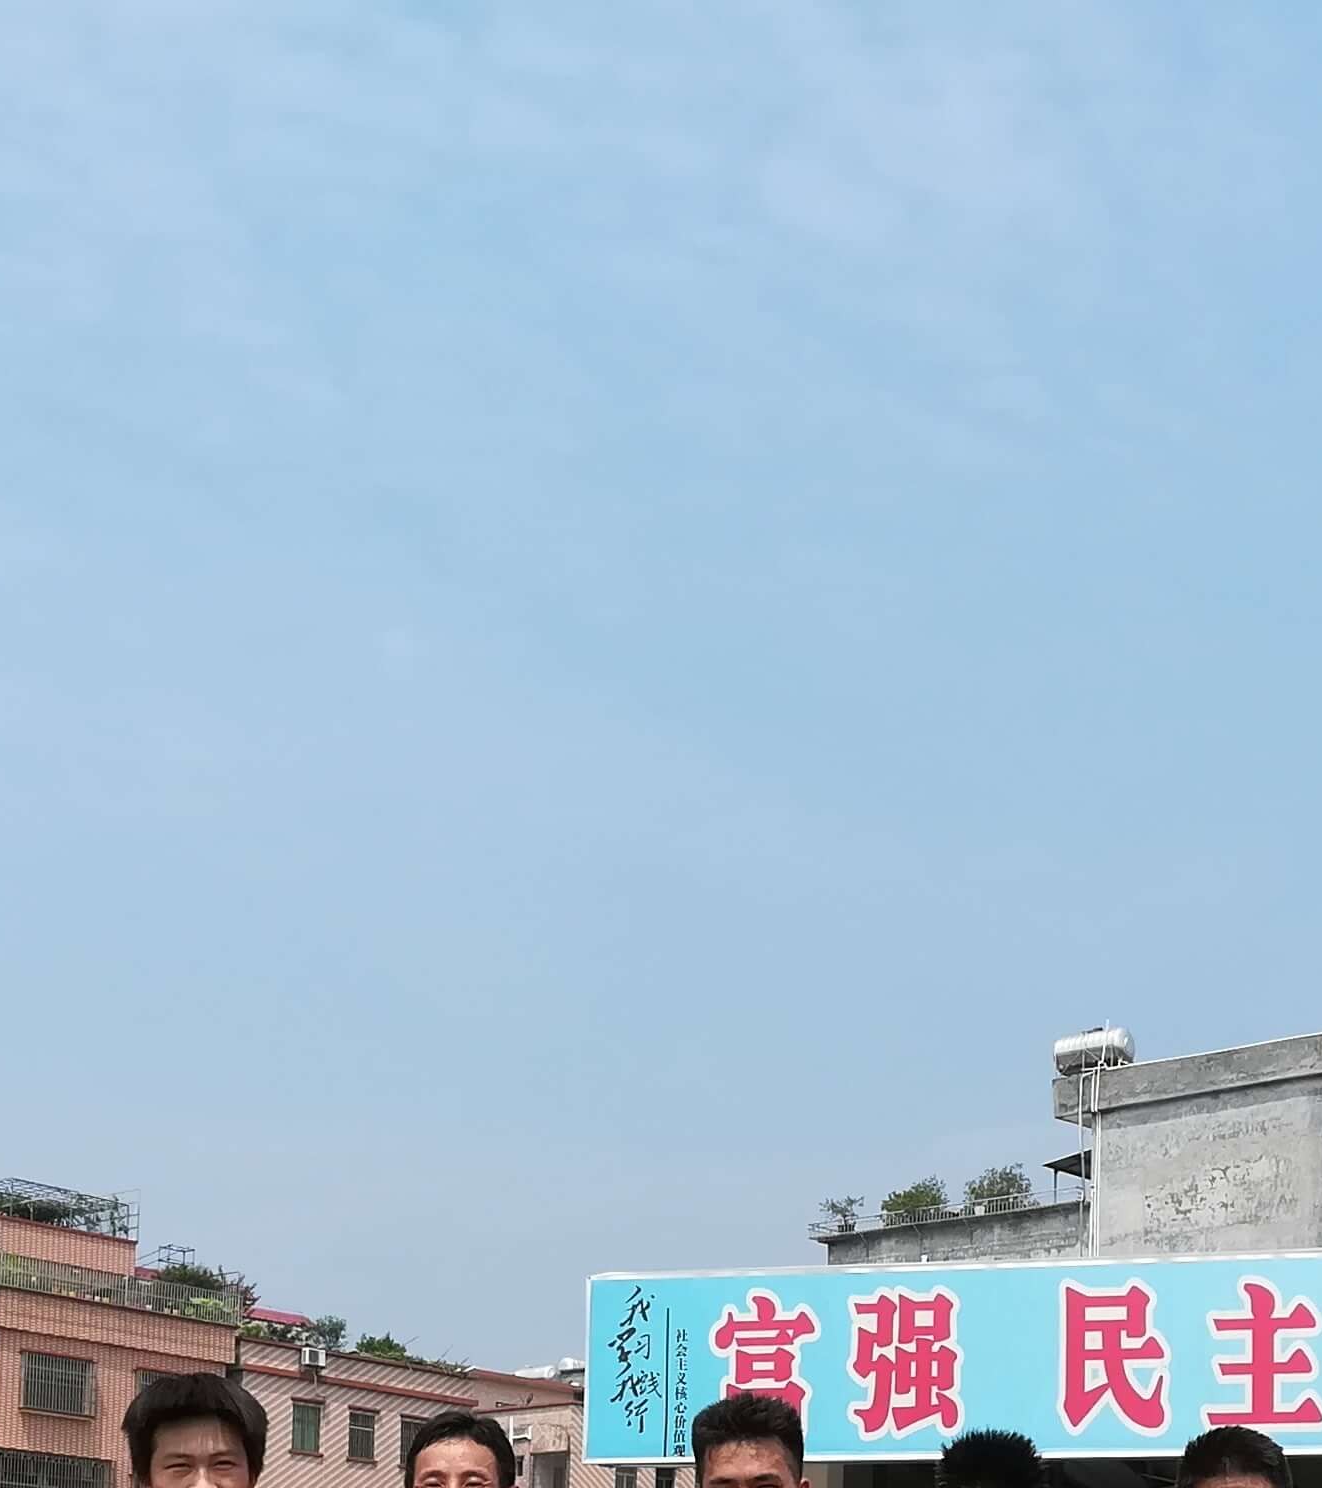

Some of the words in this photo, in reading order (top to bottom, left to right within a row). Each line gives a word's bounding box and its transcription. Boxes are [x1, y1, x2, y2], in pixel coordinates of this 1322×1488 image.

[673, 1328, 689, 1458] 社会主义核心价值观
[715, 1295, 957, 1431] 富强
[1065, 1284, 1322, 1427] 民主
